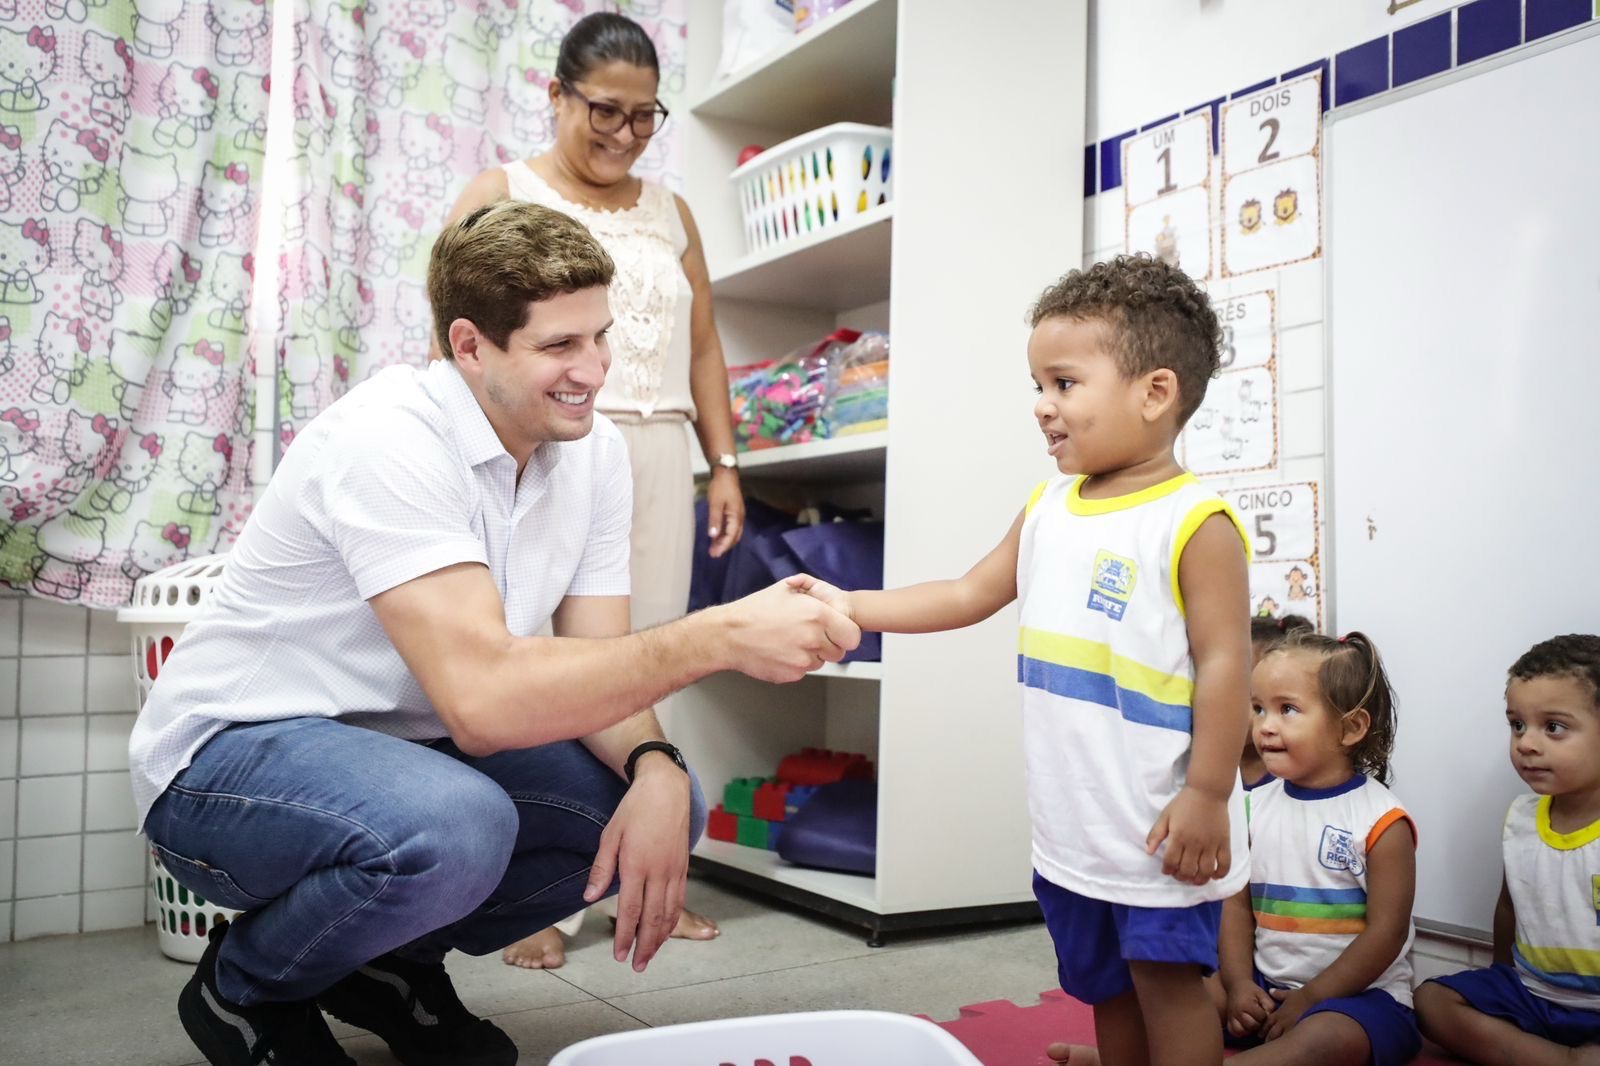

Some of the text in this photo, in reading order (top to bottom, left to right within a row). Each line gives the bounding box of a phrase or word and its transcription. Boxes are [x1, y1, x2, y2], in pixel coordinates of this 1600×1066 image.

[1250, 89, 1291, 117] DOIS
[1153, 129, 1175, 149] UM
[1257, 117, 1281, 164] 2
[1157, 147, 1178, 196] 1
[1214, 302, 1247, 323] RÊS
[1238, 490, 1293, 511] CINCO
[1255, 513, 1277, 556] 5
